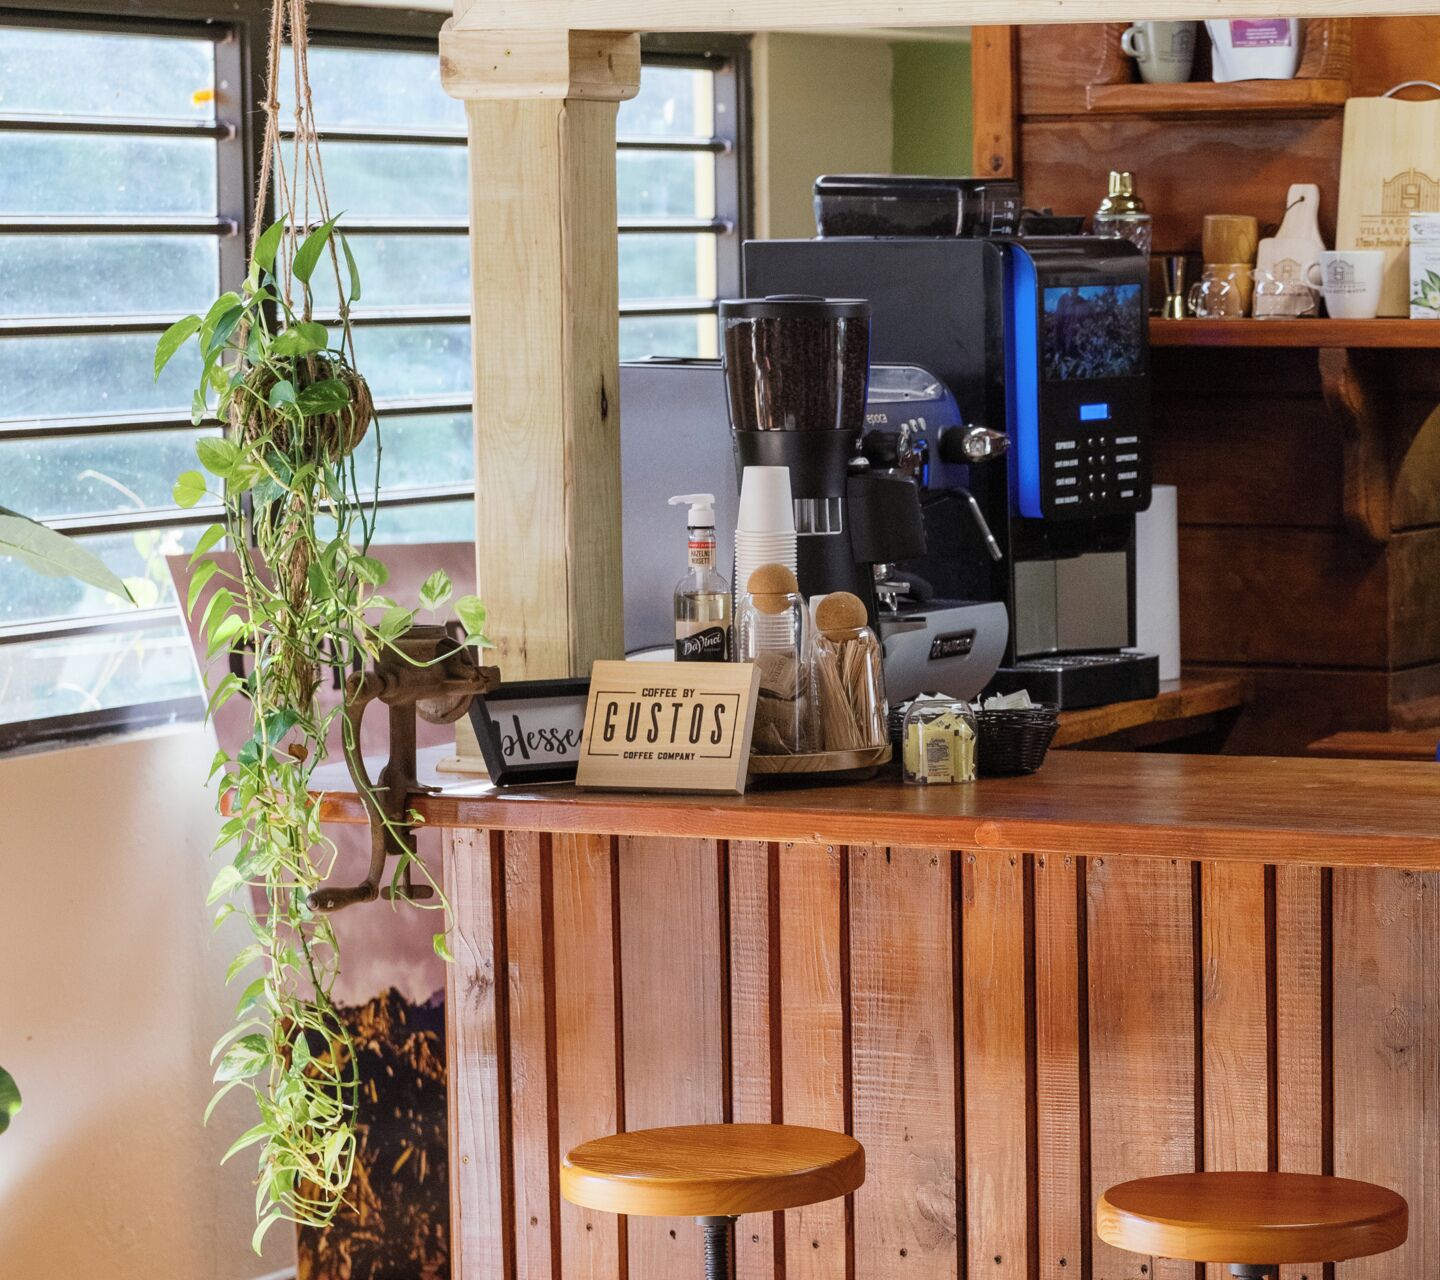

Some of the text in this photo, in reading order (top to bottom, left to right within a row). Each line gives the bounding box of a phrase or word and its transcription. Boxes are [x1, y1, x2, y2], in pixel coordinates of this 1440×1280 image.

[1360, 227, 1390, 235] VILLA
[683, 631, 721, 656] DaVinci
[641, 687, 696, 699] COFFEE BY
[603, 701, 726, 745] GUSTOS
[623, 750, 696, 762] COFFEE COMPANY
